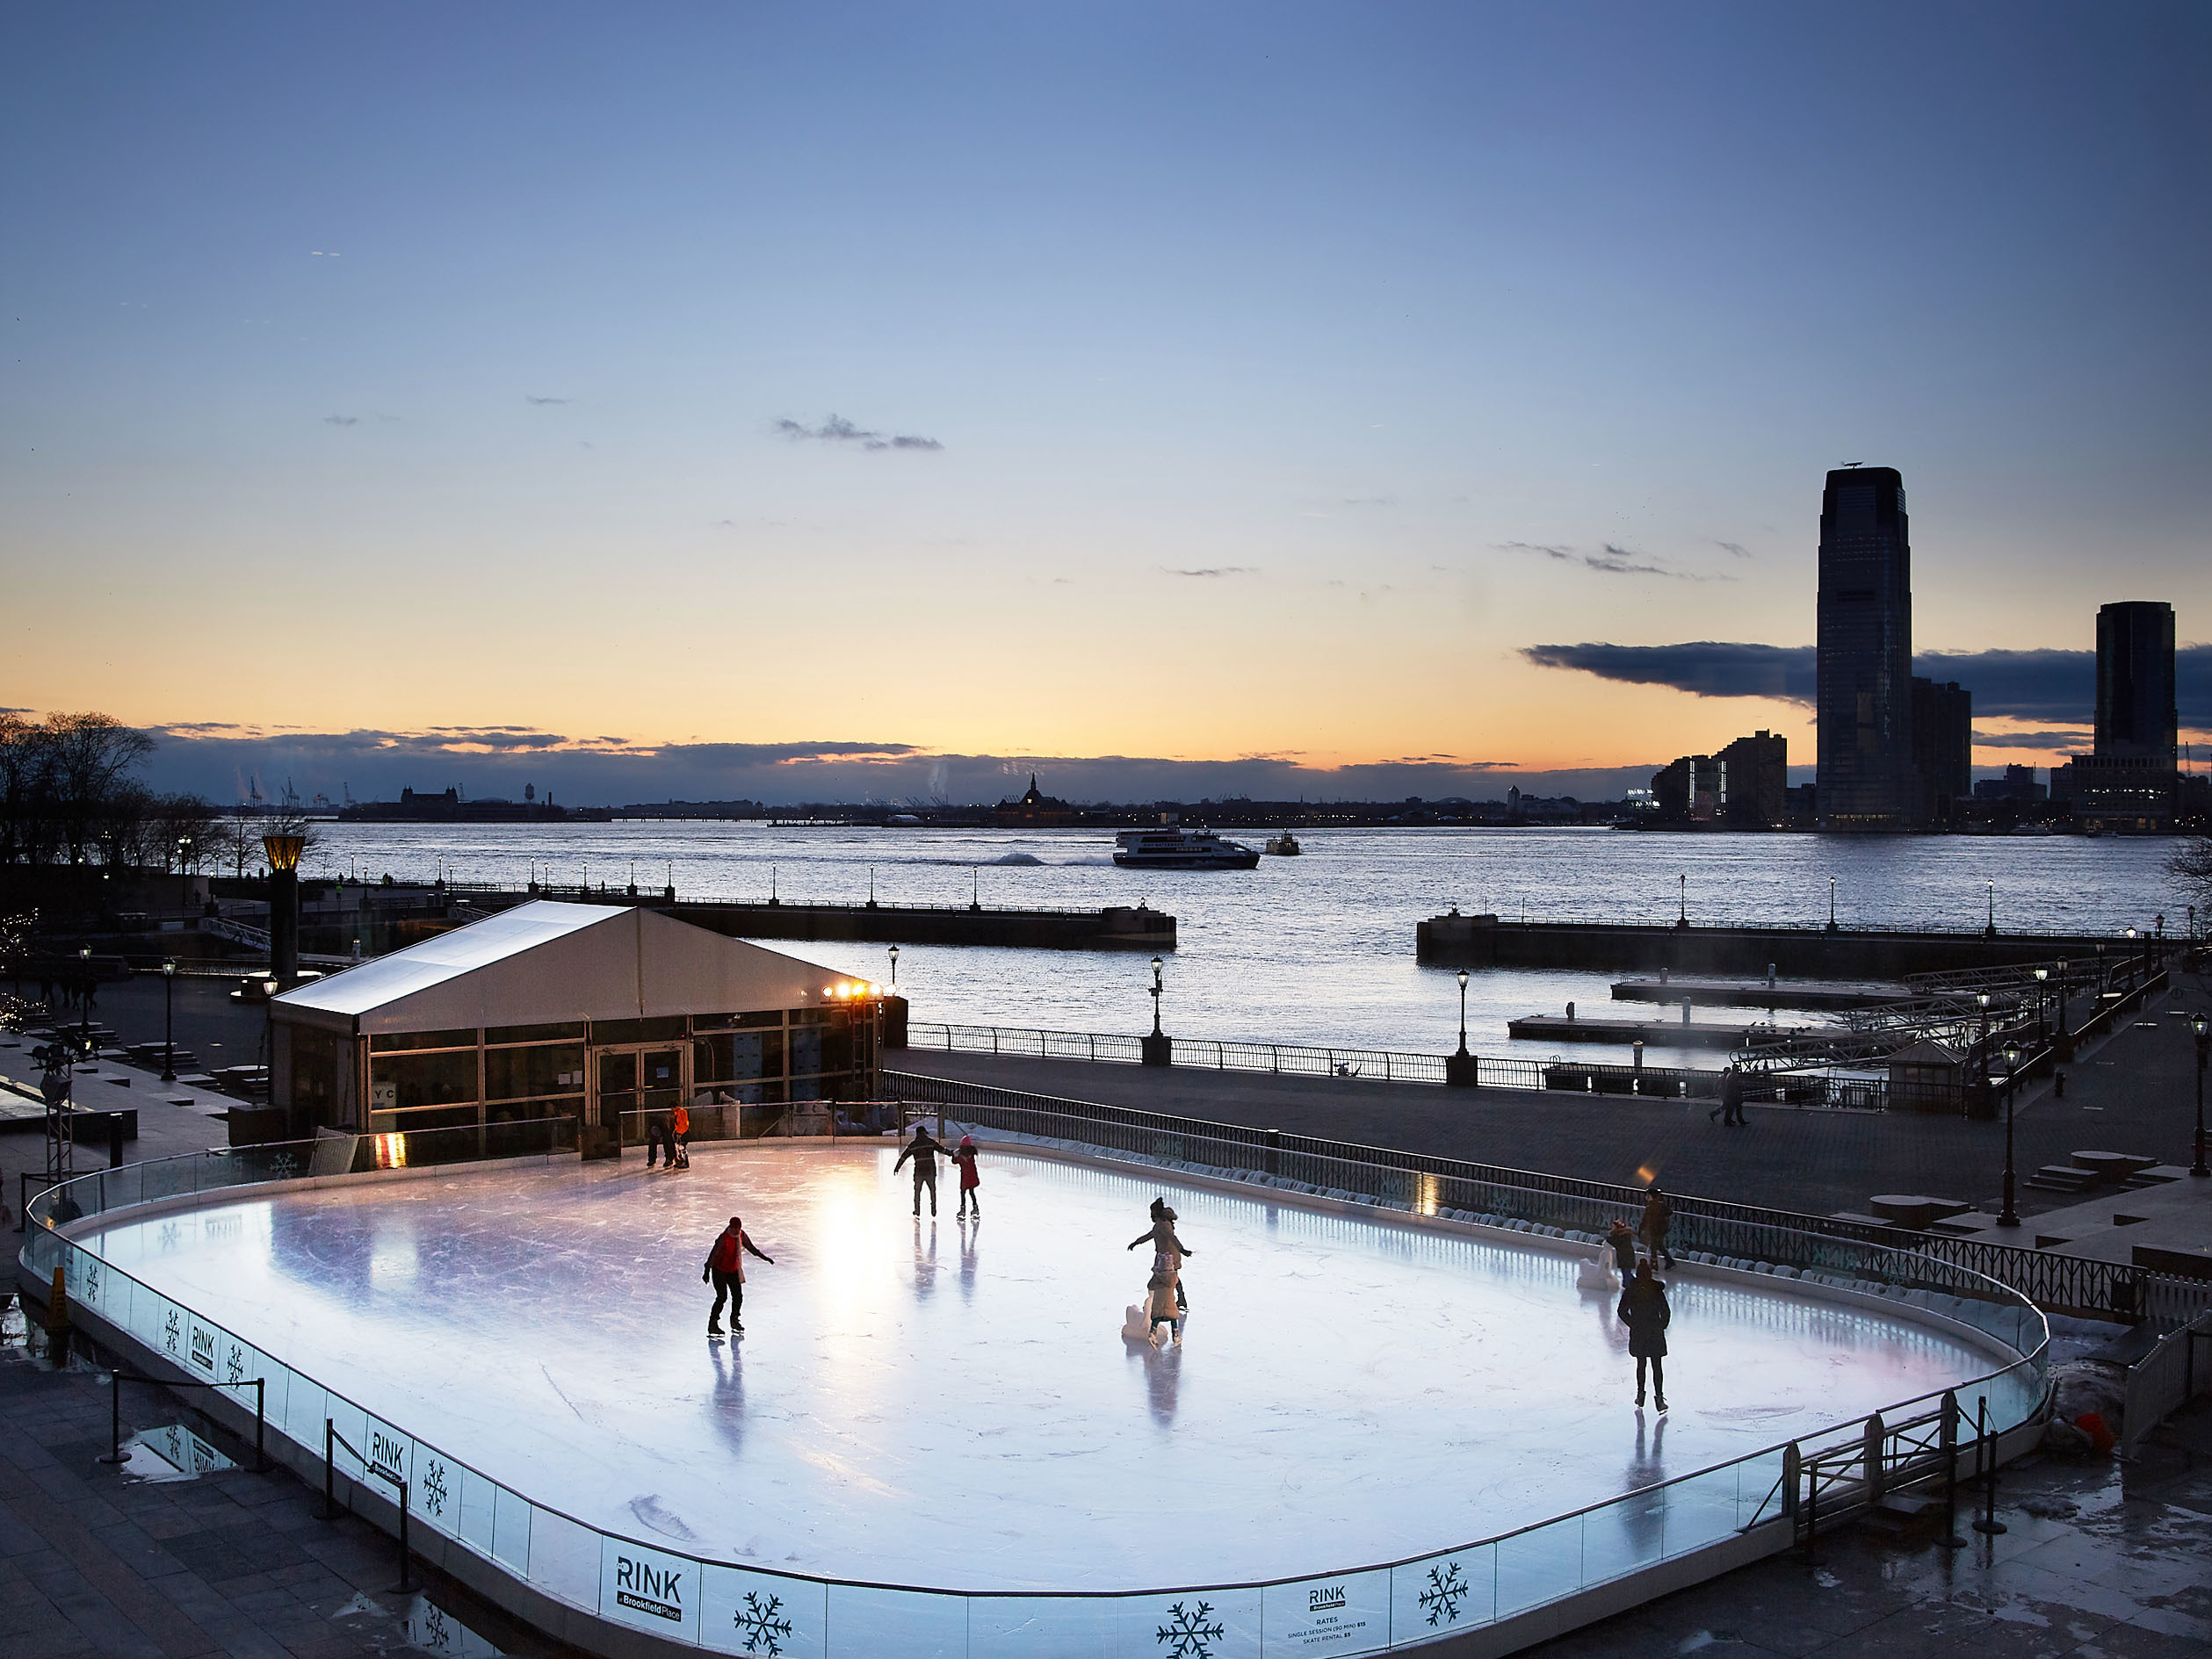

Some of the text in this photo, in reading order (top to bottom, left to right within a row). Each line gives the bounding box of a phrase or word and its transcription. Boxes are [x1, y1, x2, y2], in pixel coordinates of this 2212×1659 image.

[192, 1326, 214, 1358] RINK
[372, 1432, 403, 1473] RINK
[618, 1556, 682, 1604] RINK
[1310, 1585, 1345, 1604] RINK
[623, 1595, 661, 1614] Brookfield
[1309, 1627, 1333, 1635] SESSION
[1316, 1617, 1338, 1626] RATES
[1303, 1636, 1320, 1645] SKATE
